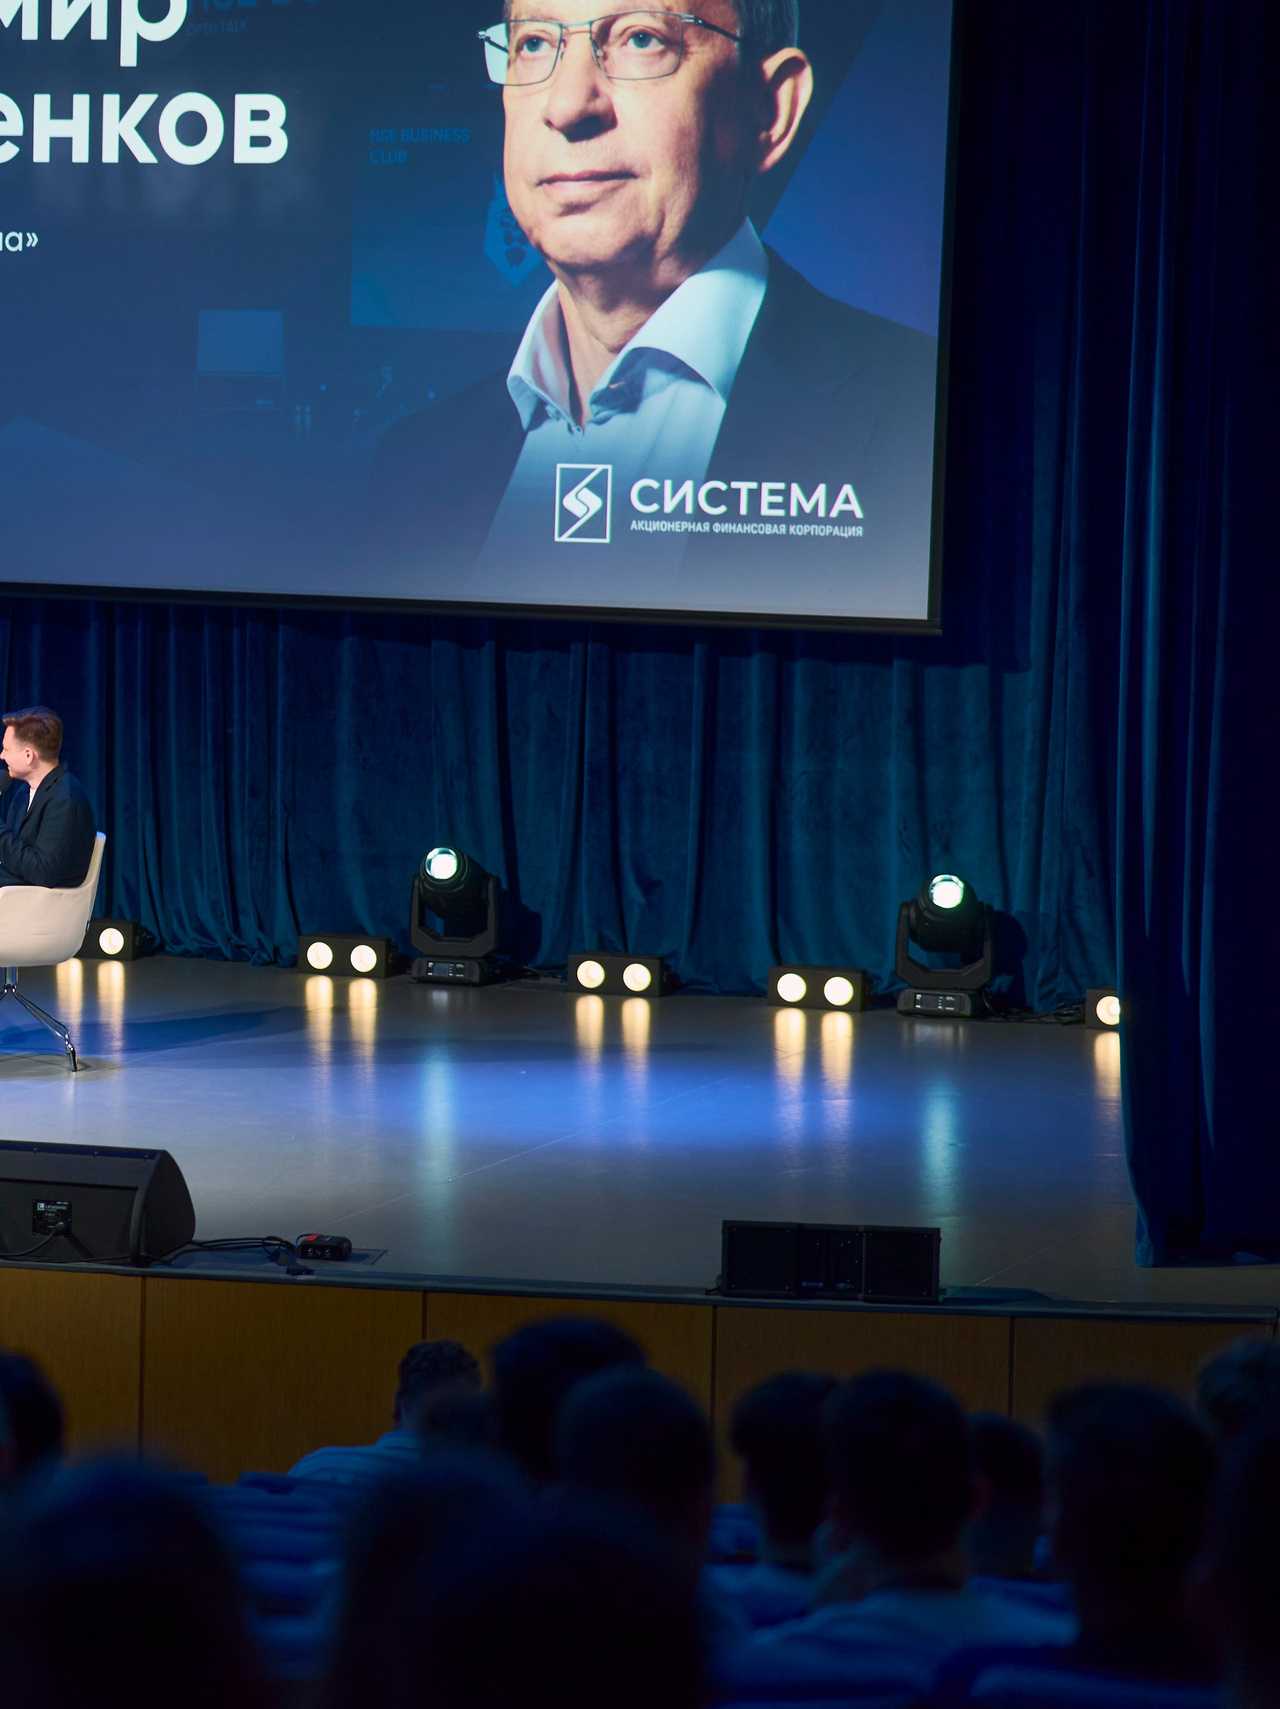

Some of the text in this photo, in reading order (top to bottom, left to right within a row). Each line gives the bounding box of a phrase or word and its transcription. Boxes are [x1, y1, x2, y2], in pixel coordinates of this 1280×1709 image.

[370, 127, 470, 142] HSE BUSINESS
[370, 149, 407, 164] CLUB
[630, 478, 864, 519] СИСТЕМА
[630, 519, 864, 539] АКЦИОНЕРНАЯ ФИНАНСОВАЯ КОРПОРАЦИЯ
